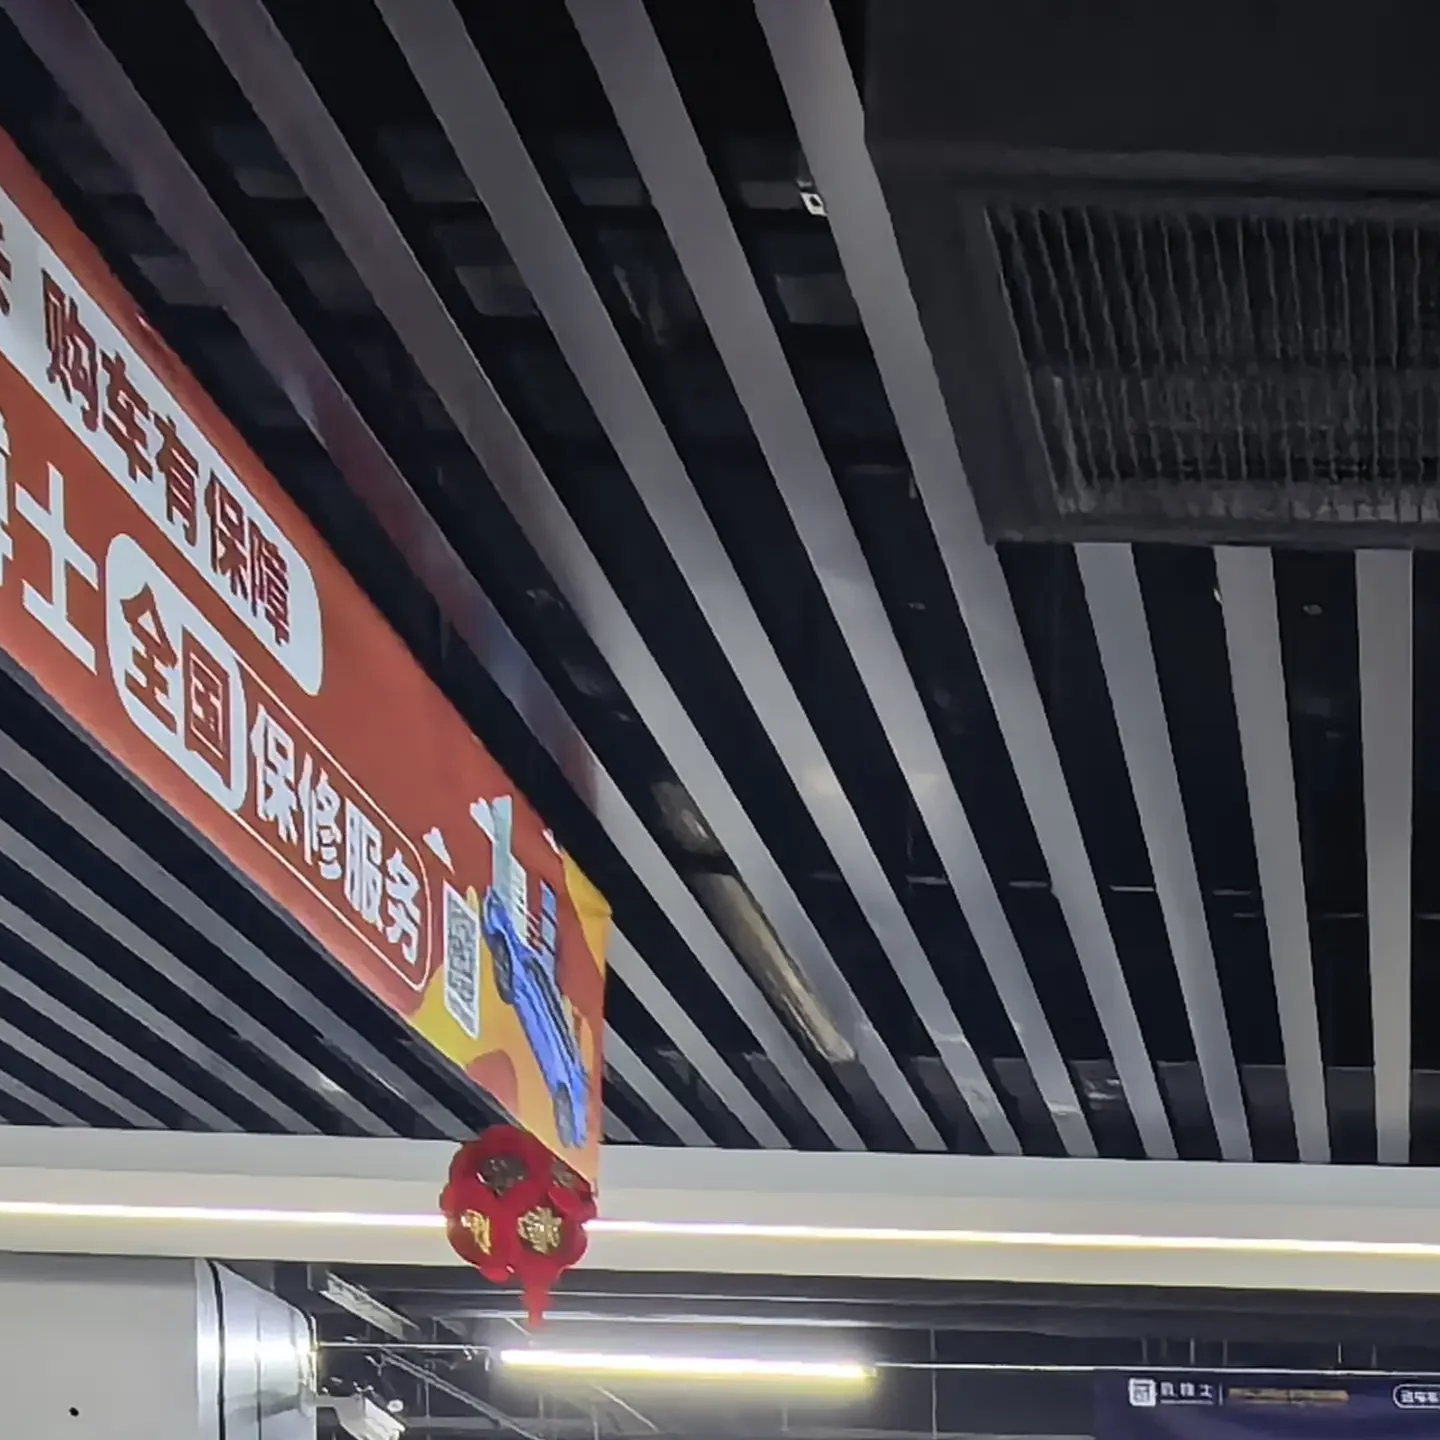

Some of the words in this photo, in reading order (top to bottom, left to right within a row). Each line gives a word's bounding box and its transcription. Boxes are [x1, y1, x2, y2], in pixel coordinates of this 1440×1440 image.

[42, 268, 291, 645] 购车有保障
